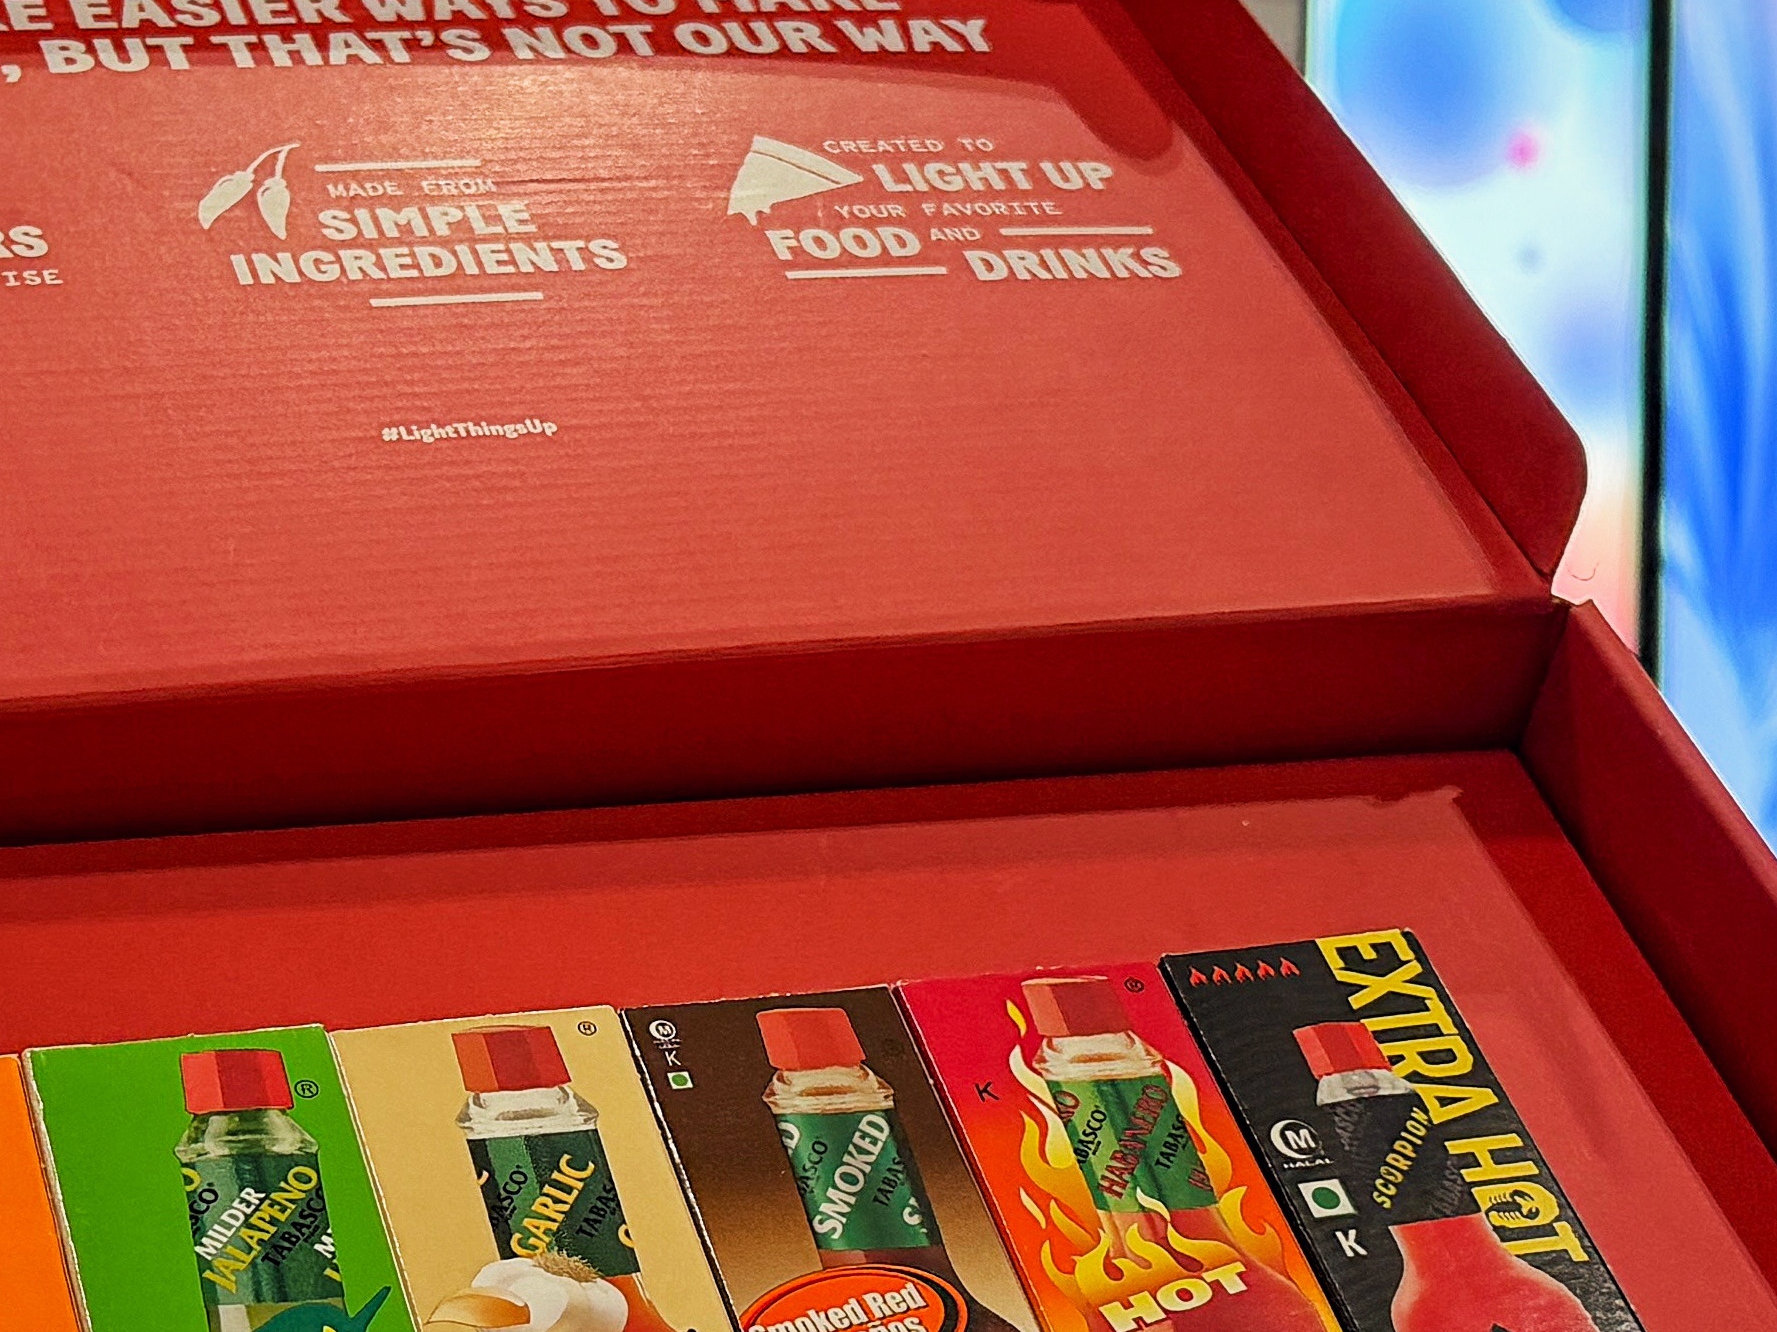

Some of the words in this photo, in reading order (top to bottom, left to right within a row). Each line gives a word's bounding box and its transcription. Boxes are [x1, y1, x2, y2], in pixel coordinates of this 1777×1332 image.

[46, 35, 199, 76] BUT
[210, 24, 489, 69] THAT'S
[506, 24, 661, 61] NOT
[690, 20, 830, 56] OUR
[844, 18, 994, 54] WAY
[821, 136, 946, 155] CREATED
[958, 136, 996, 154] TO
[327, 179, 403, 199] MADE
[423, 176, 496, 197] FROM
[872, 161, 1036, 194] LIGHT
[1050, 161, 1114, 191] UP
[318, 202, 538, 243] SIMPLE
[833, 201, 907, 219] YOUR
[922, 199, 1063, 219] FAVORITE
[229, 236, 628, 286] INGREDIENTS
[764, 226, 922, 262] FOOD
[928, 225, 982, 244] AND
[964, 246, 1182, 284] DRINKS
[382, 417, 559, 444] #LightThingsUp
[665, 1050, 681, 1066] K
[975, 1081, 999, 1102] K
[1316, 929, 1499, 1125] EXTRA
[1444, 1133, 1590, 1262] HOT
[1283, 1158, 1333, 1169] HALAL
[1372, 1107, 1429, 1209] SCORPION
[812, 1114, 890, 1240] SMOKED
[195, 1187, 266, 1261] MILDER
[510, 1153, 595, 1258] GARLIC
[1335, 1229, 1368, 1258] K
[863, 1281, 927, 1319] Red
